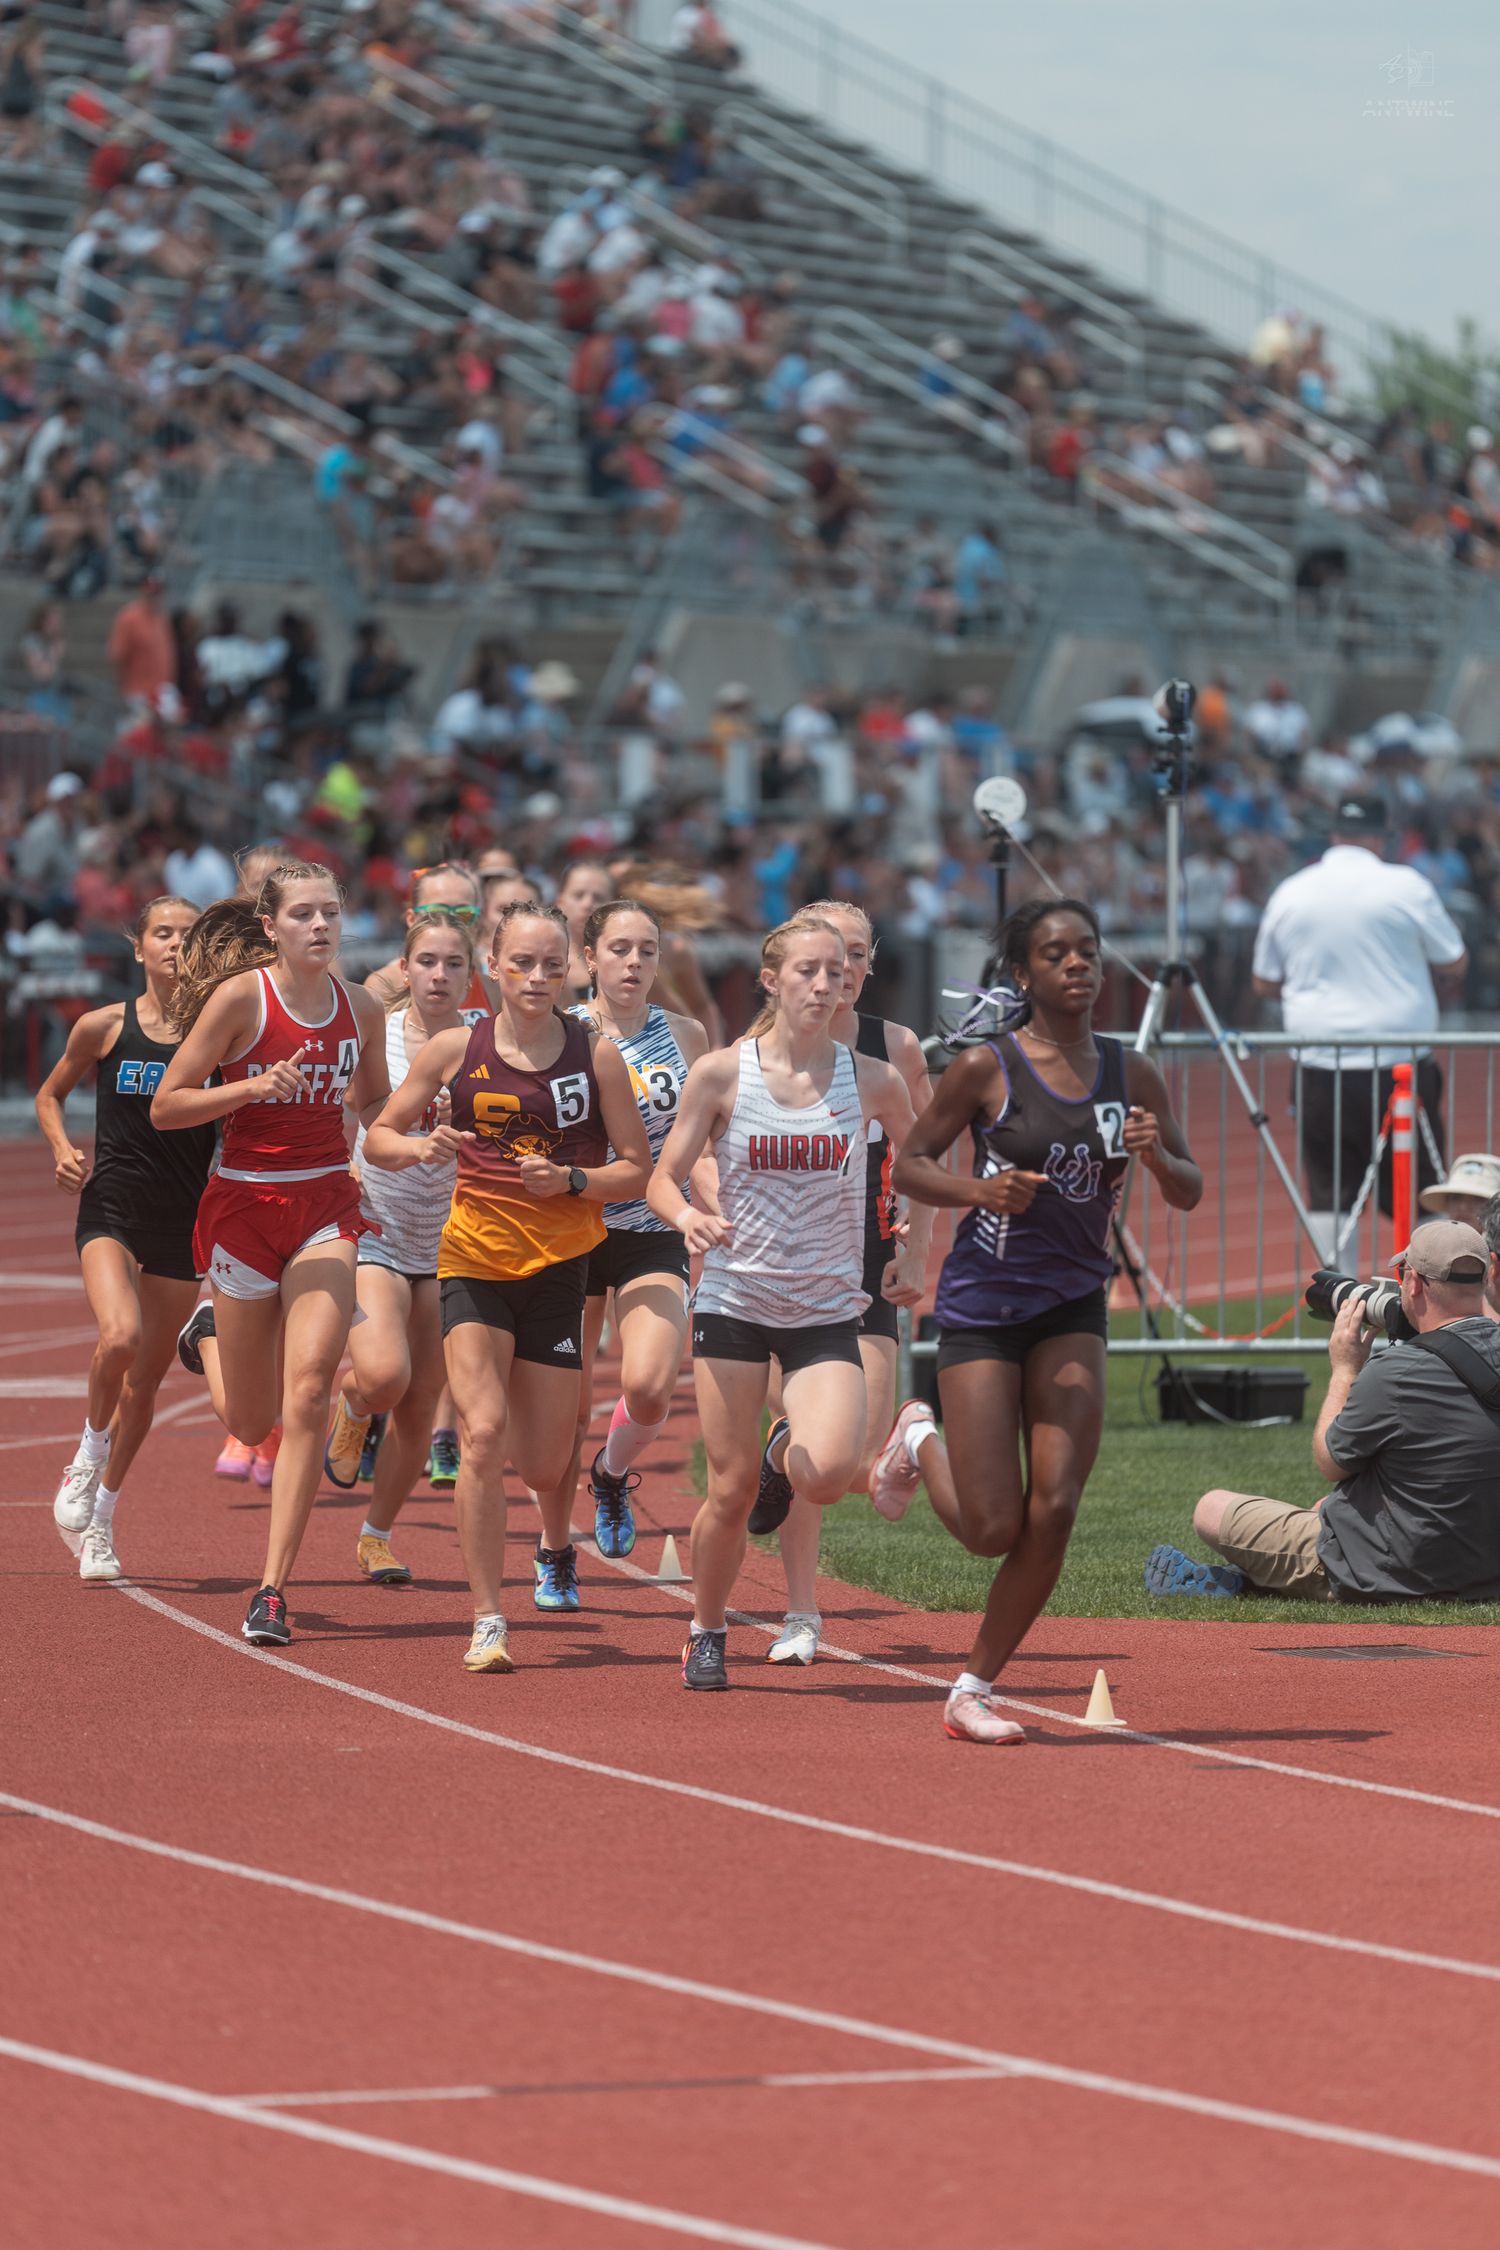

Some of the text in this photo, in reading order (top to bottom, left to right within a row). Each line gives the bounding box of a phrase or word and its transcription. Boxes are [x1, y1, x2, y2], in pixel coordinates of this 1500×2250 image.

[116, 1060, 167, 1095] EA
[340, 1042, 354, 1083] 4
[557, 1078, 585, 1122] 5
[650, 1071, 677, 1112] 3
[1102, 1107, 1126, 1154] 2
[749, 1133, 852, 1176] HURON
